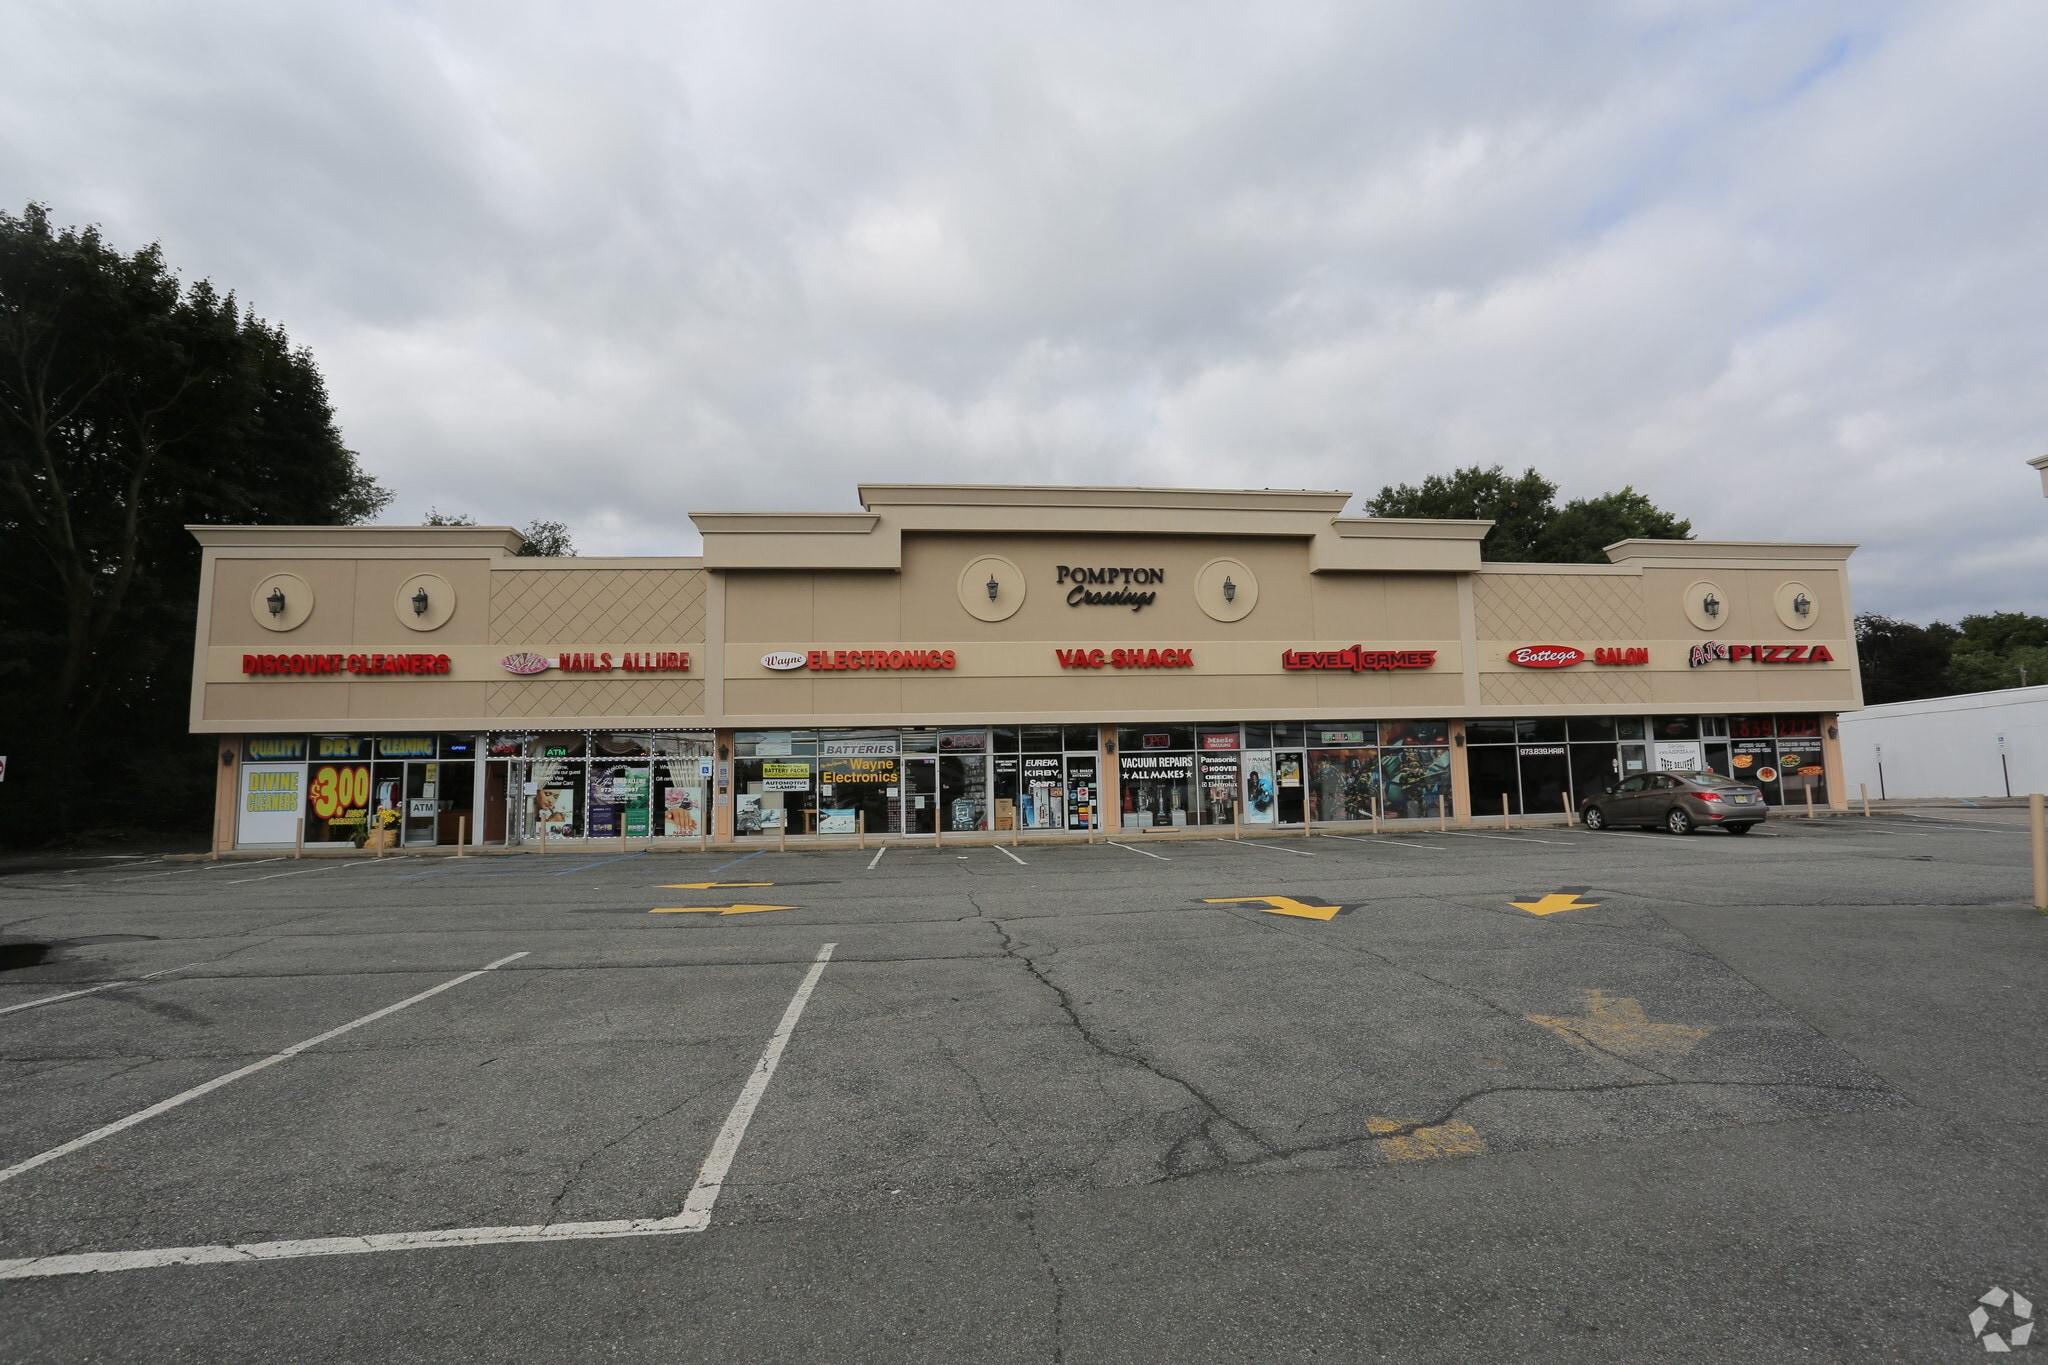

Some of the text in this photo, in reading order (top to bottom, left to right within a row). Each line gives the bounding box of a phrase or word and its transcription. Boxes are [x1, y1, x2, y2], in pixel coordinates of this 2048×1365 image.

[1056, 565, 1164, 584] POMPTON
[1066, 584, 1157, 612] Crossings
[764, 649, 957, 671] Wayne ELECTRONICS
[1055, 648, 1194, 669] VAC SHACK
[1284, 650, 1350, 667] LEVEL
[1363, 651, 1433, 666] GAMES
[1515, 647, 1650, 665] Bottega SALON
[1690, 640, 1835, 668] AJ's PIZZA
[242, 653, 451, 674] DISCOUNT CLEANERS
[559, 652, 613, 672] NAILS
[622, 652, 691, 671] ALLURE
[940, 735, 984, 749] OPEN
[1144, 735, 1169, 747] OPEN
[249, 737, 434, 760] QUALITY DRY CLEANING
[546, 748, 567, 756] ATM
[826, 745, 894, 754] BATTERIES
[1520, 747, 1565, 755] 973.839.HAIR
[850, 758, 894, 772] Wayne
[1025, 759, 1059, 767] EUREKA
[1121, 756, 1193, 768] VACUUM REPAIRS
[1660, 757, 1695, 771] FREE DELIVERY
[823, 771, 898, 783] Electronics
[1024, 769, 1060, 777] KIRBY
[1131, 770, 1184, 779] ALL MAKES
[248, 771, 299, 791] DIVINE
[1029, 779, 1056, 787] Sears
[310, 766, 369, 817] $3.00
[247, 791, 299, 812] CLEANERS
[413, 803, 433, 811] ATM
